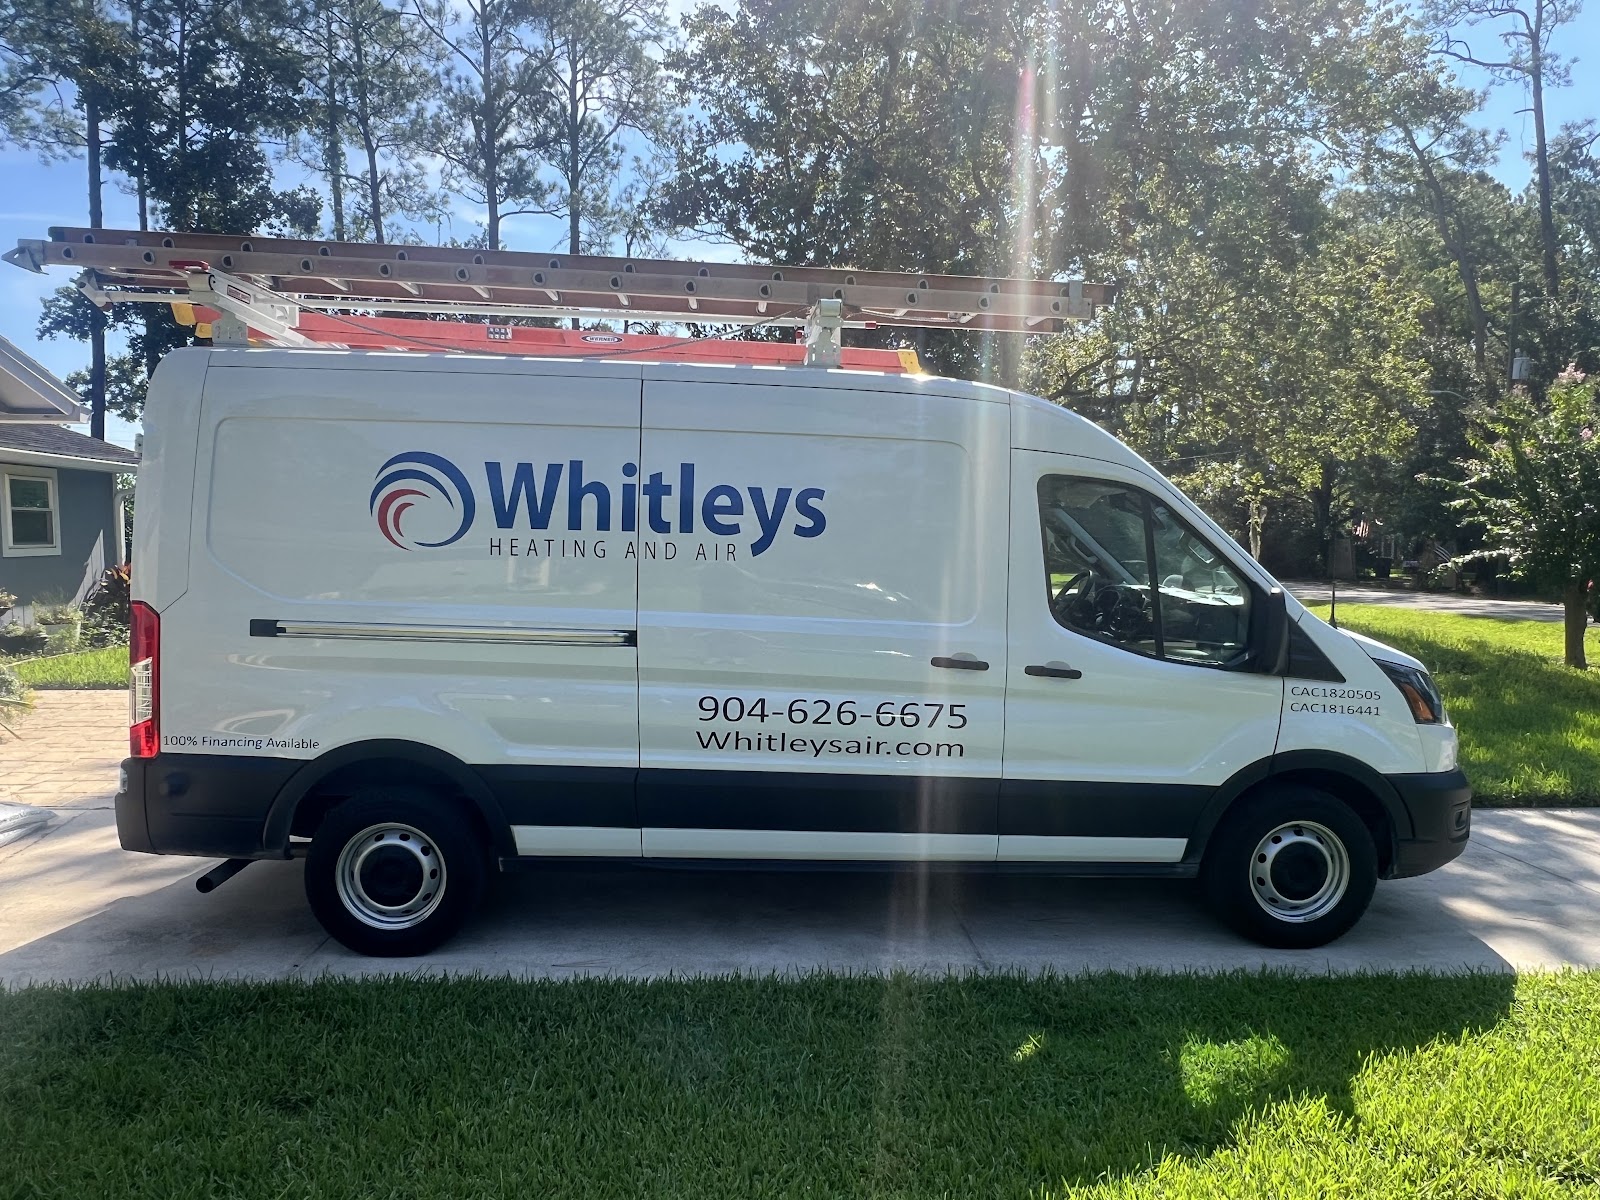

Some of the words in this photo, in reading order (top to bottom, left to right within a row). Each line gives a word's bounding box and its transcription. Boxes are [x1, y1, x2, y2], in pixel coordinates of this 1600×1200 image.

[484, 460, 827, 557] Whitleys
[489, 538, 607, 559] HEATING
[625, 541, 677, 560] AND
[695, 543, 737, 562] AIR
[1291, 686, 1381, 701] CAC1820505
[698, 695, 968, 729] 904-626-6675
[1290, 702, 1381, 717] CAC1816441
[163, 735, 198, 747] 100%
[201, 736, 263, 750] Financing
[265, 737, 320, 750] Available
[695, 730, 965, 757] Whitleysair.com
